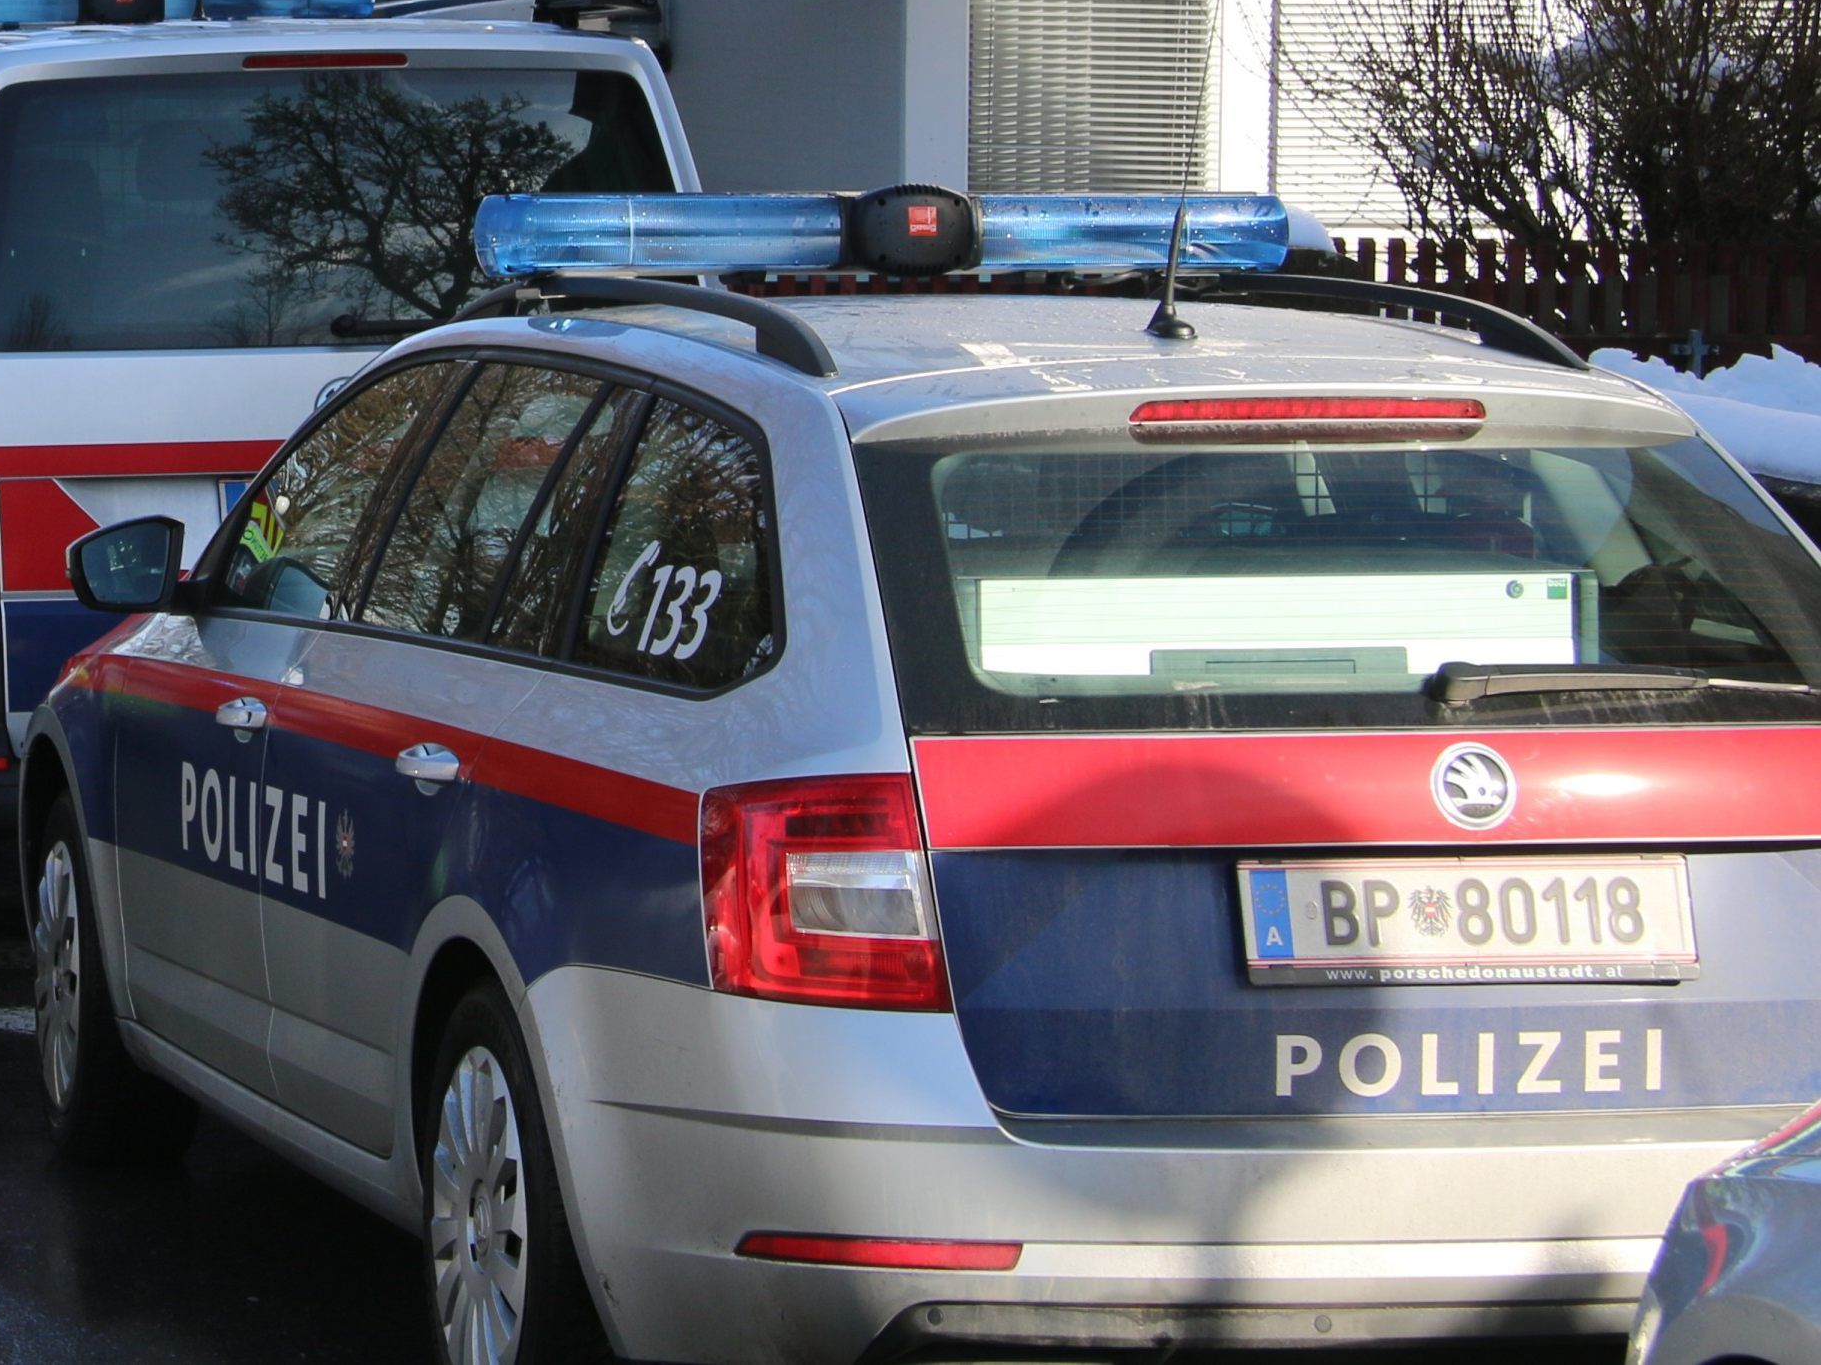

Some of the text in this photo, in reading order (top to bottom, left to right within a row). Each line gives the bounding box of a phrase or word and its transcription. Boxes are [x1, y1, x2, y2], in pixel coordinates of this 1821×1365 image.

[636, 564, 723, 660] 133
[181, 761, 327, 900] POLIZEI
[1265, 876, 1646, 949] A BP 80118
[1275, 1028, 1663, 1097] POLIZEI
